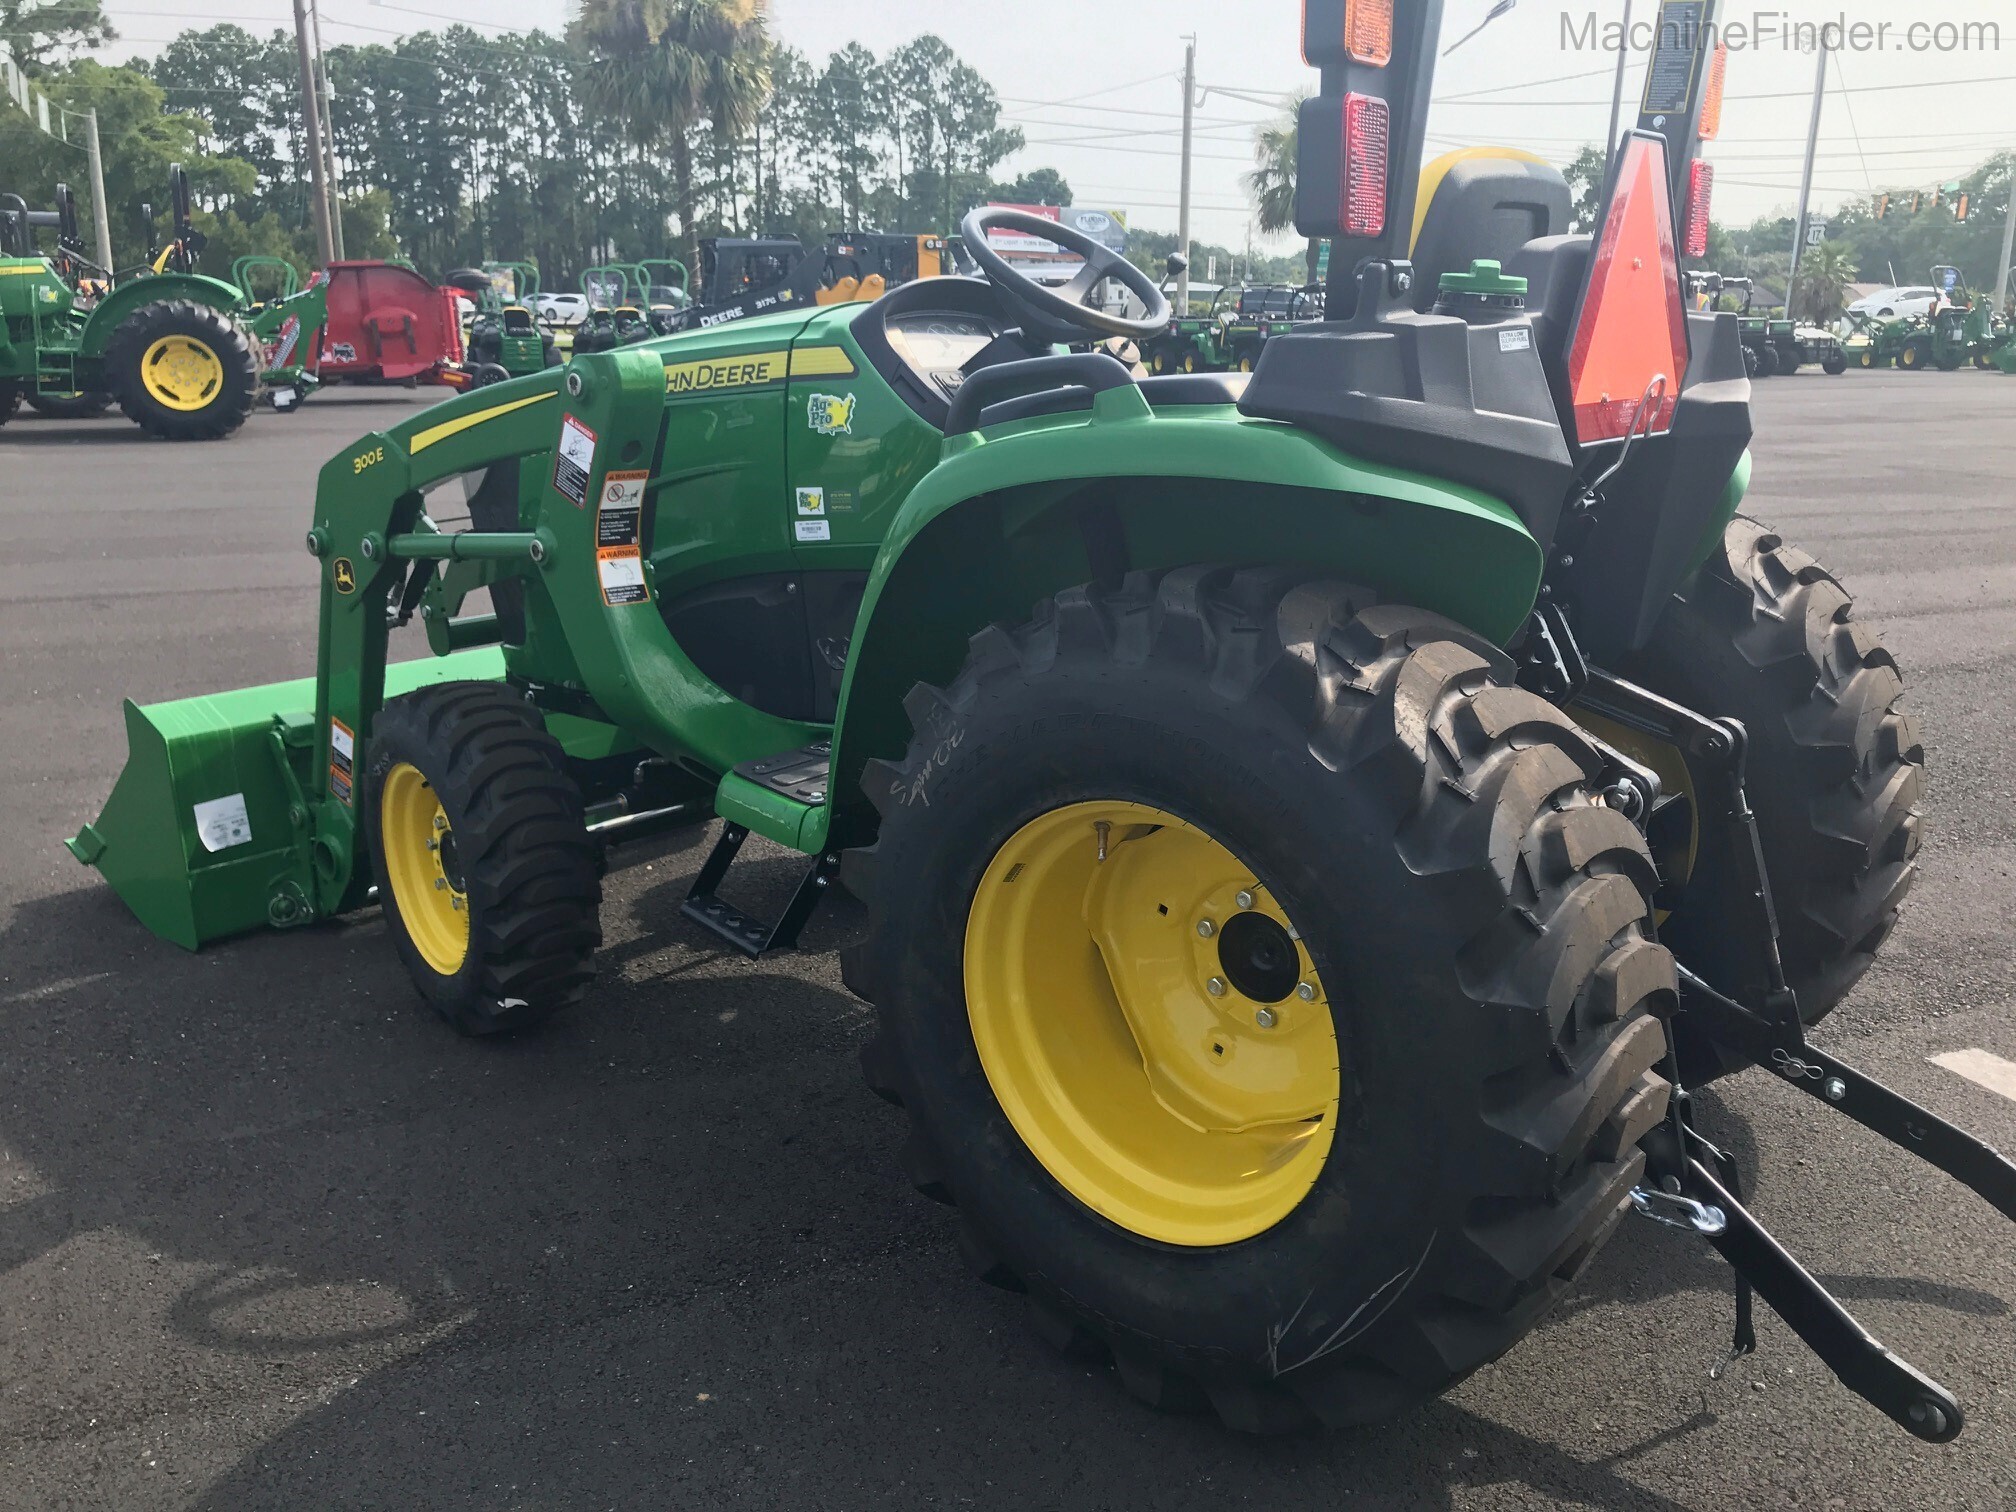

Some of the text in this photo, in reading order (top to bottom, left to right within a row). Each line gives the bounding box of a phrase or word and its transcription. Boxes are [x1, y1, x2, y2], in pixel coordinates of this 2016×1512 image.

[700, 297, 777, 328] DEERE 317G
[666, 362, 770, 391] HN DEERE
[810, 412, 832, 425] Pro
[615, 471, 647, 481] WARNING
[606, 548, 639, 559] WARNING
